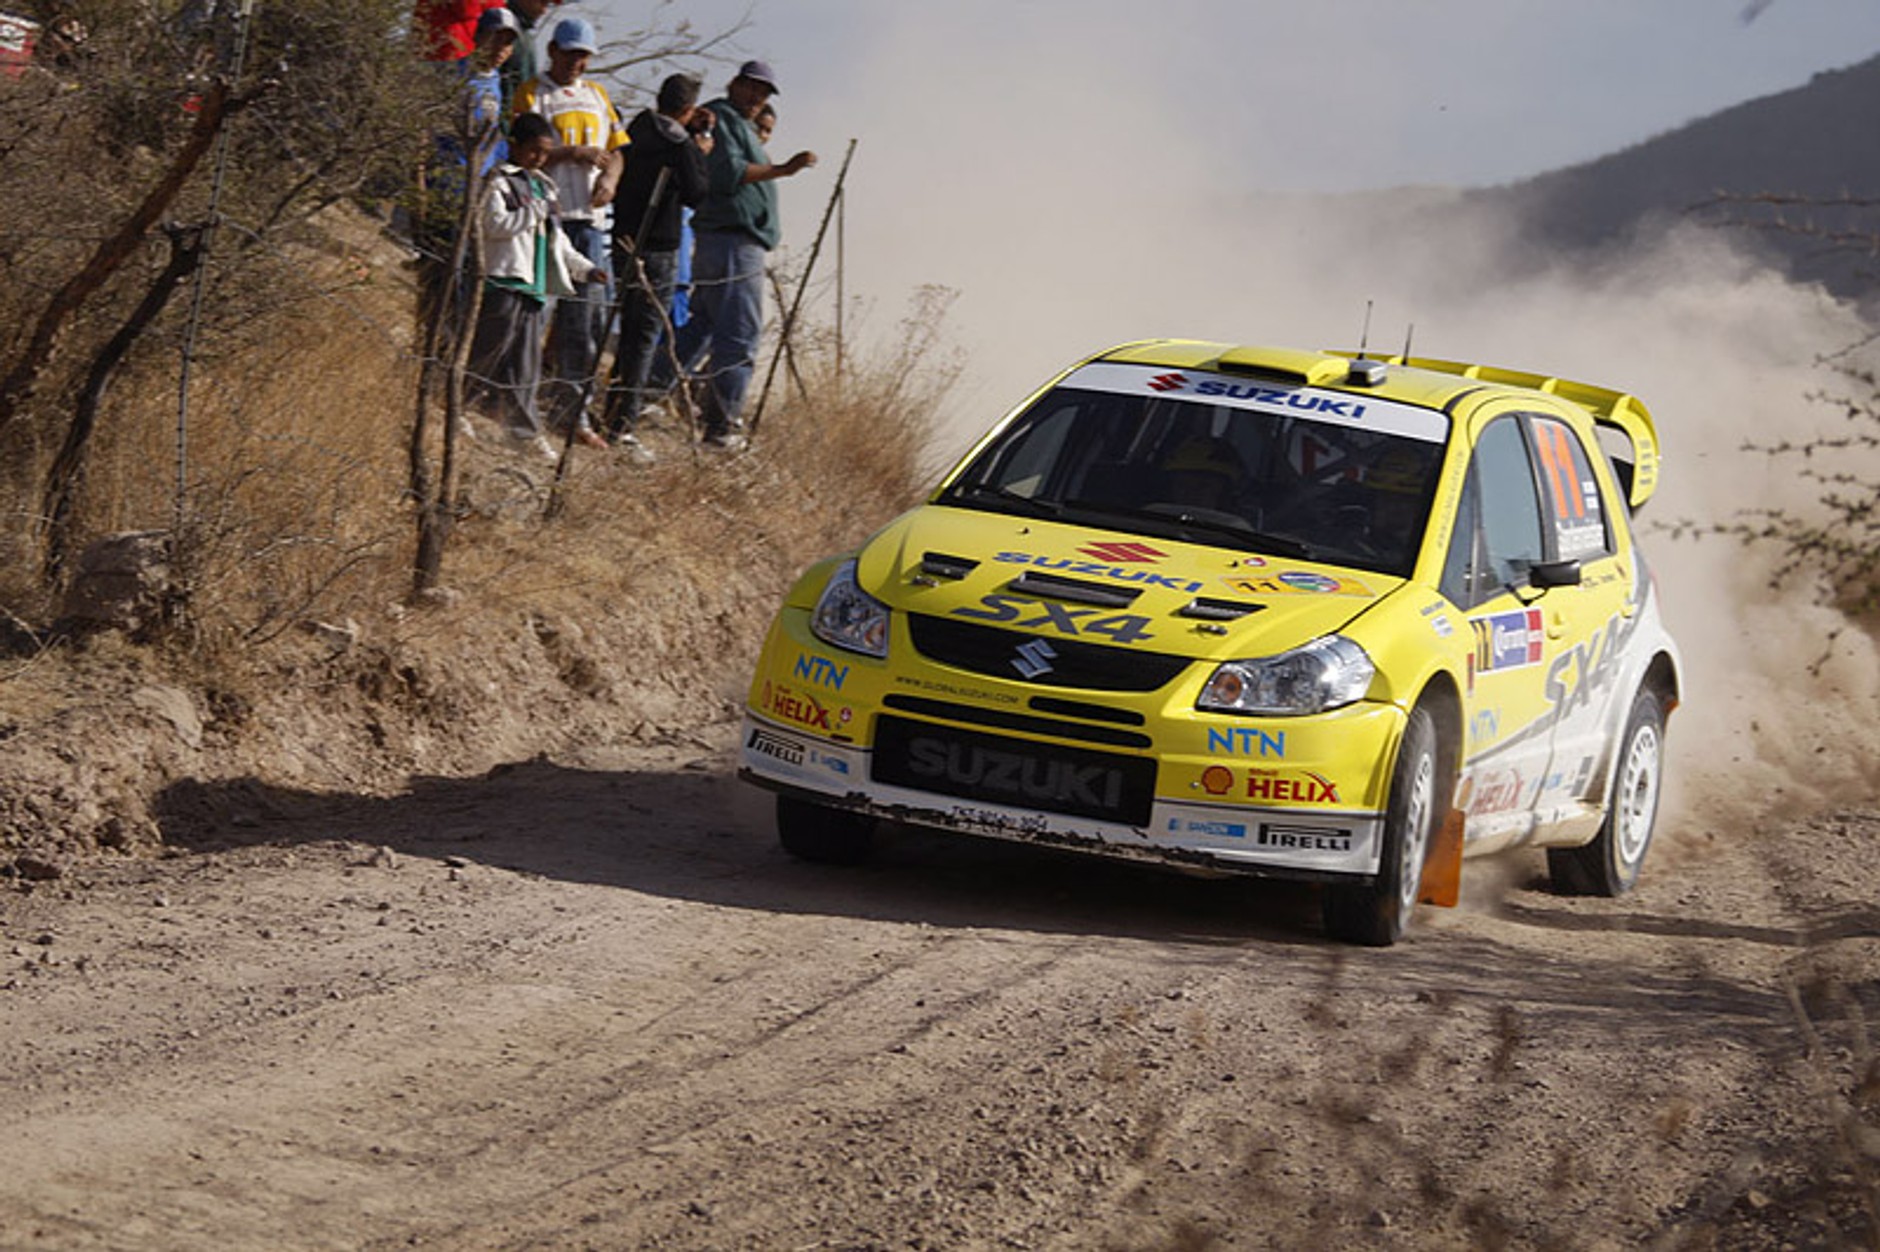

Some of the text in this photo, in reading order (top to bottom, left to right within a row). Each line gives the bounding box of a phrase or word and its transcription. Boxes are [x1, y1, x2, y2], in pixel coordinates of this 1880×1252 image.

[1195, 380, 1366, 420] SUZUKI
[1536, 422, 1585, 519] 11
[992, 551, 1204, 593] SUZUKI
[951, 595, 1154, 644] SX4
[794, 653, 850, 691] NTN
[773, 692, 831, 731] HELIX
[747, 728, 805, 766] PIRELLI
[1208, 726, 1285, 757] NTN
[908, 736, 1123, 809] SUZUKI
[1247, 771, 1341, 803] HELIX
[1258, 822, 1353, 851] PIRELLI
